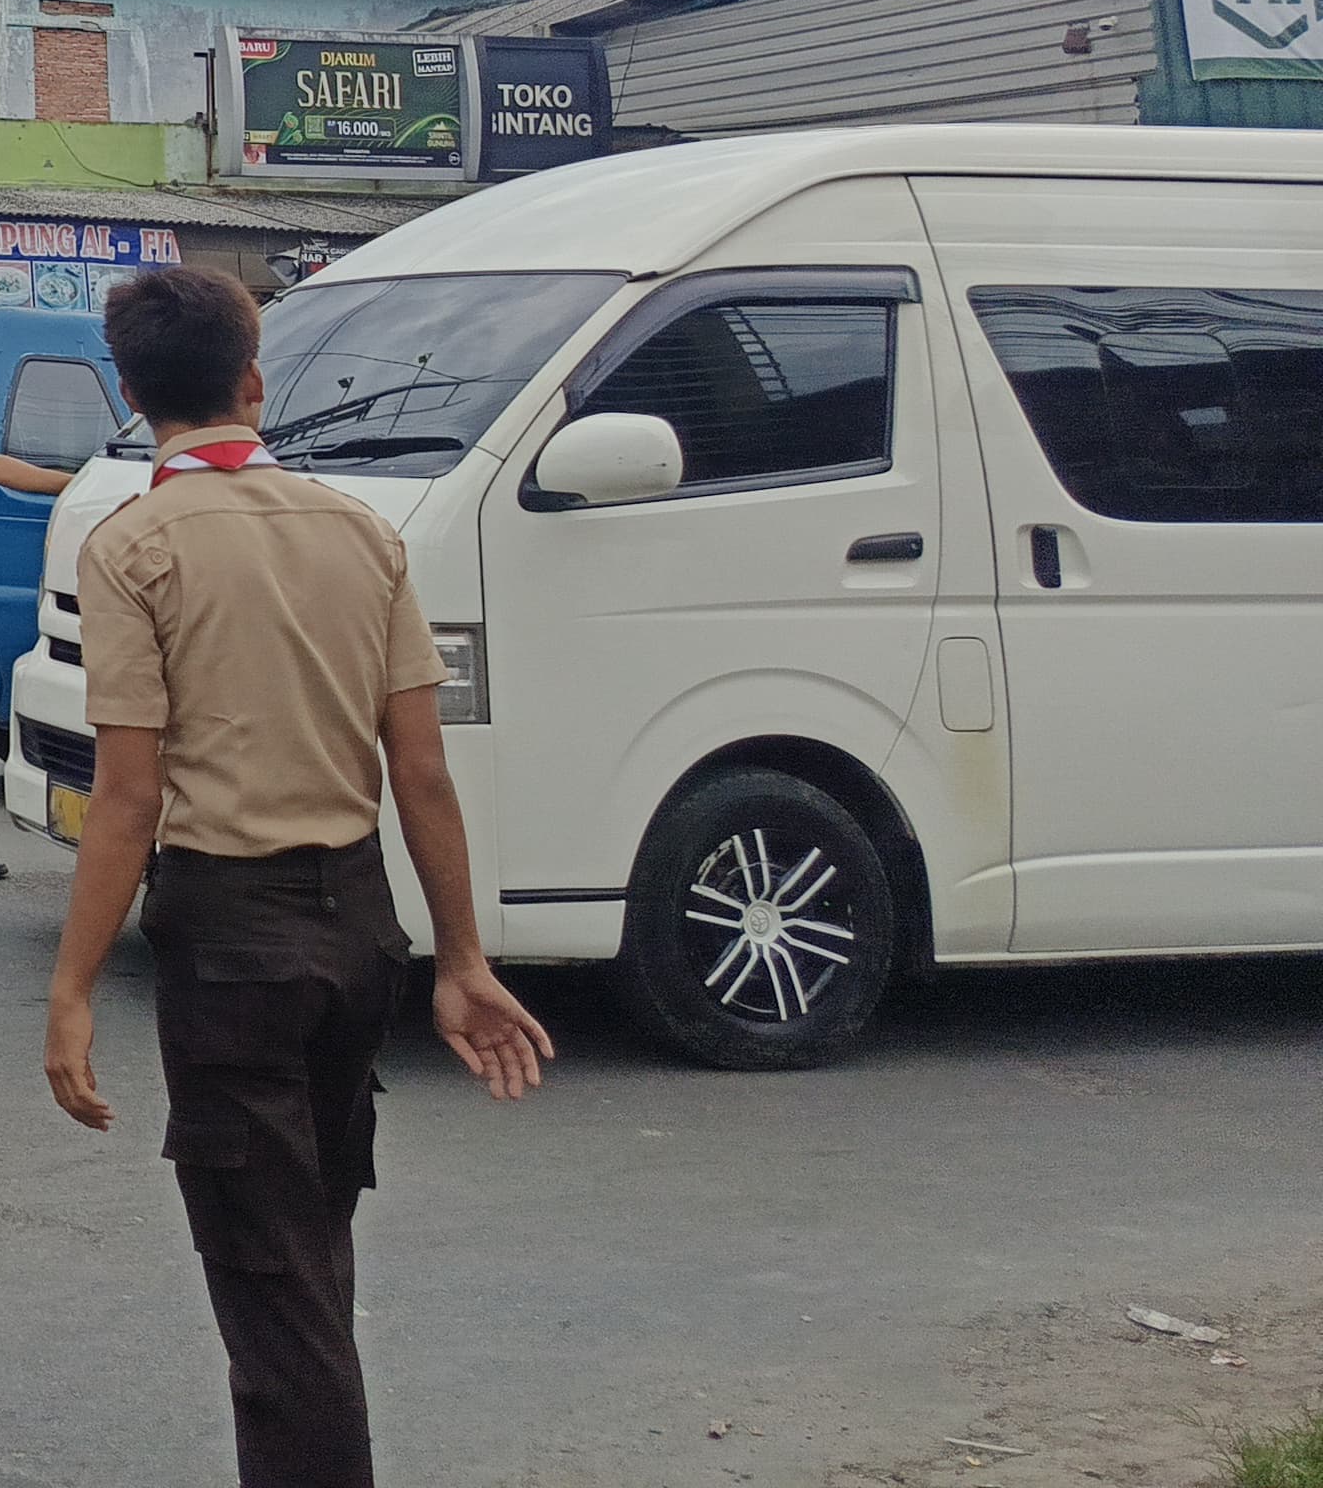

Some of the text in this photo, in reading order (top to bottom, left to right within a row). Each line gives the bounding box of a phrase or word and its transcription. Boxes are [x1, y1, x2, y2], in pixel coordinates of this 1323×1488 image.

[321, 51, 376, 67] DJARUM
[417, 52, 452, 63] LEBIH
[296, 70, 403, 110] SAFARI
[497, 83, 573, 109] TOKO
[337, 121, 379, 136] 16.000
[80, 225, 115, 260] AL
